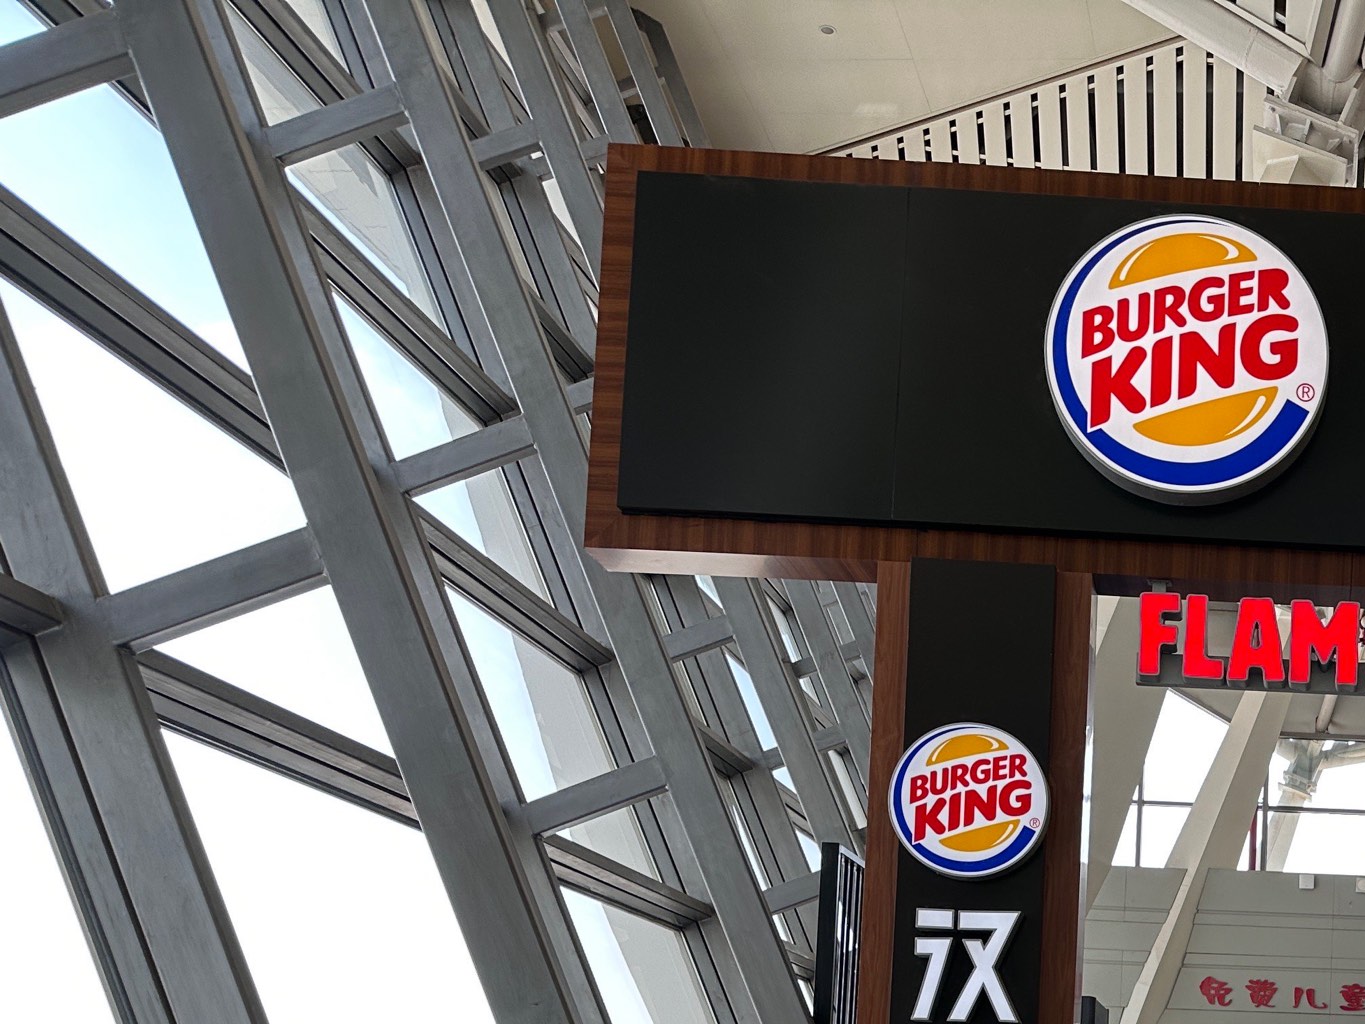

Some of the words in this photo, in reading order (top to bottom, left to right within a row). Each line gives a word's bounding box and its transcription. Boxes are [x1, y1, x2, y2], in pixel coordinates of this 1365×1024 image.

[1081, 268, 1291, 359] BURGER
[1090, 313, 1299, 429] KING
[910, 754, 1027, 804] BURGER
[914, 780, 1032, 842] KING
